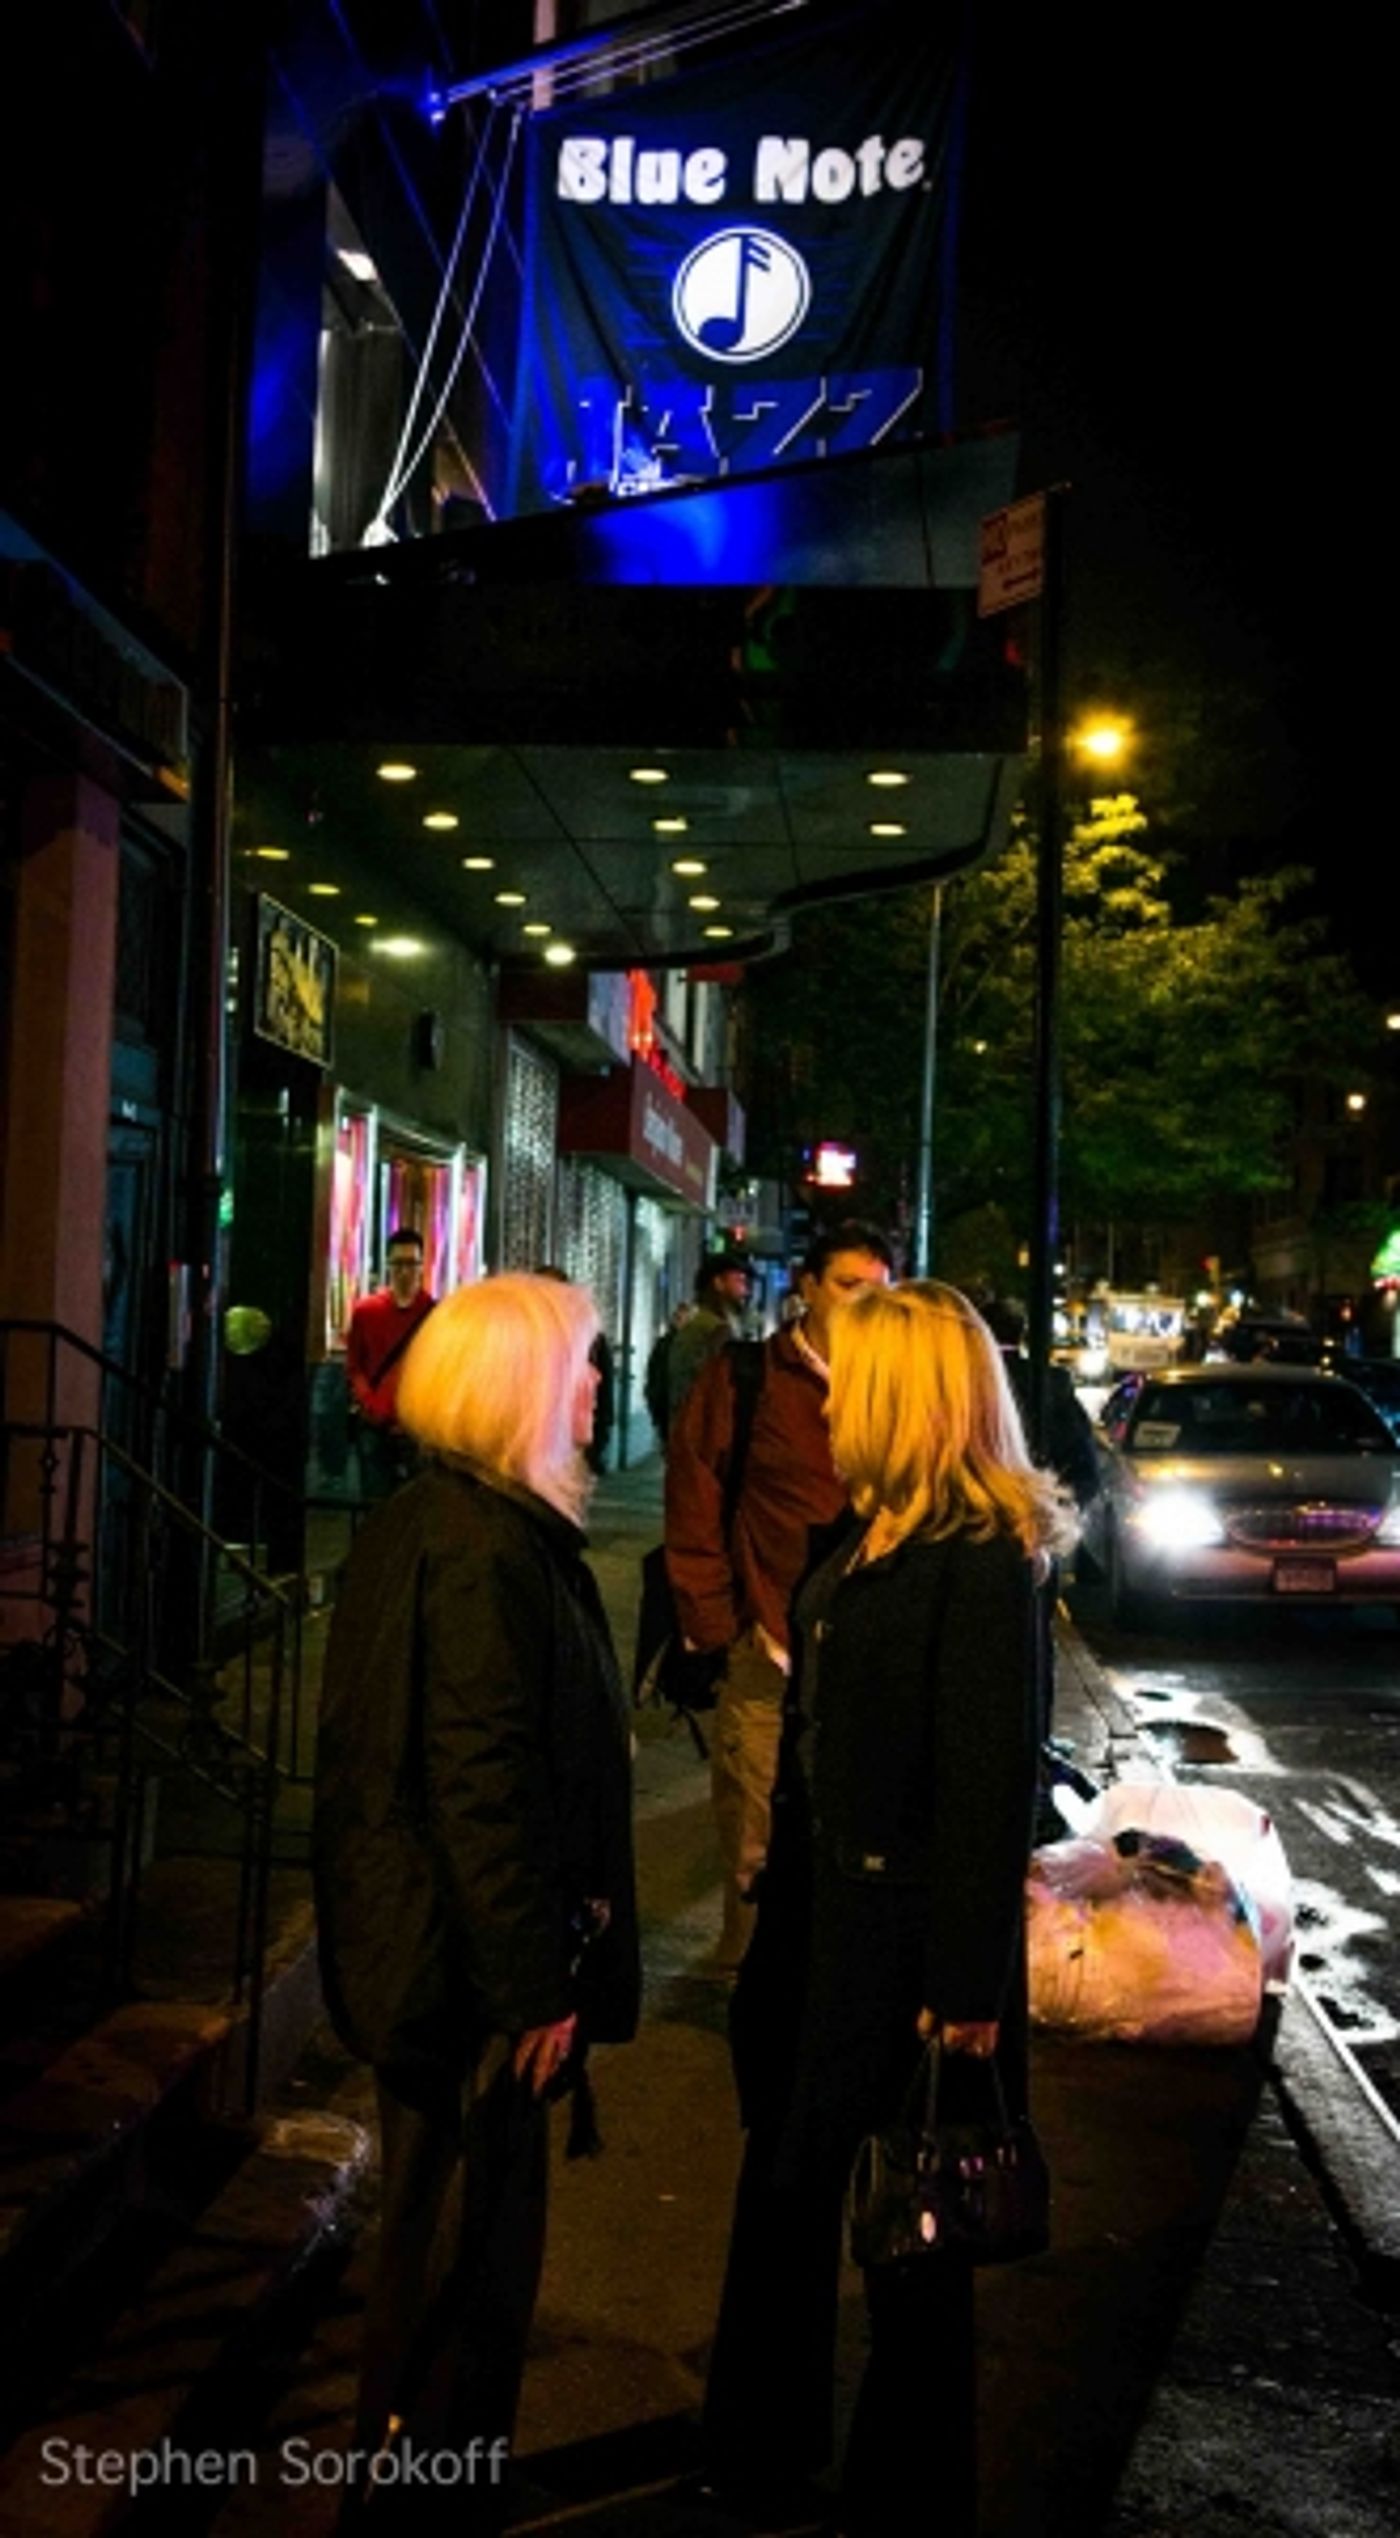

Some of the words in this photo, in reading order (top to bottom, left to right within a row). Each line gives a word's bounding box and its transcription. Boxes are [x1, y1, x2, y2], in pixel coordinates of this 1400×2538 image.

[557, 136, 727, 205] Blue
[753, 134, 925, 205] Note
[548, 366, 923, 505] JAZZ
